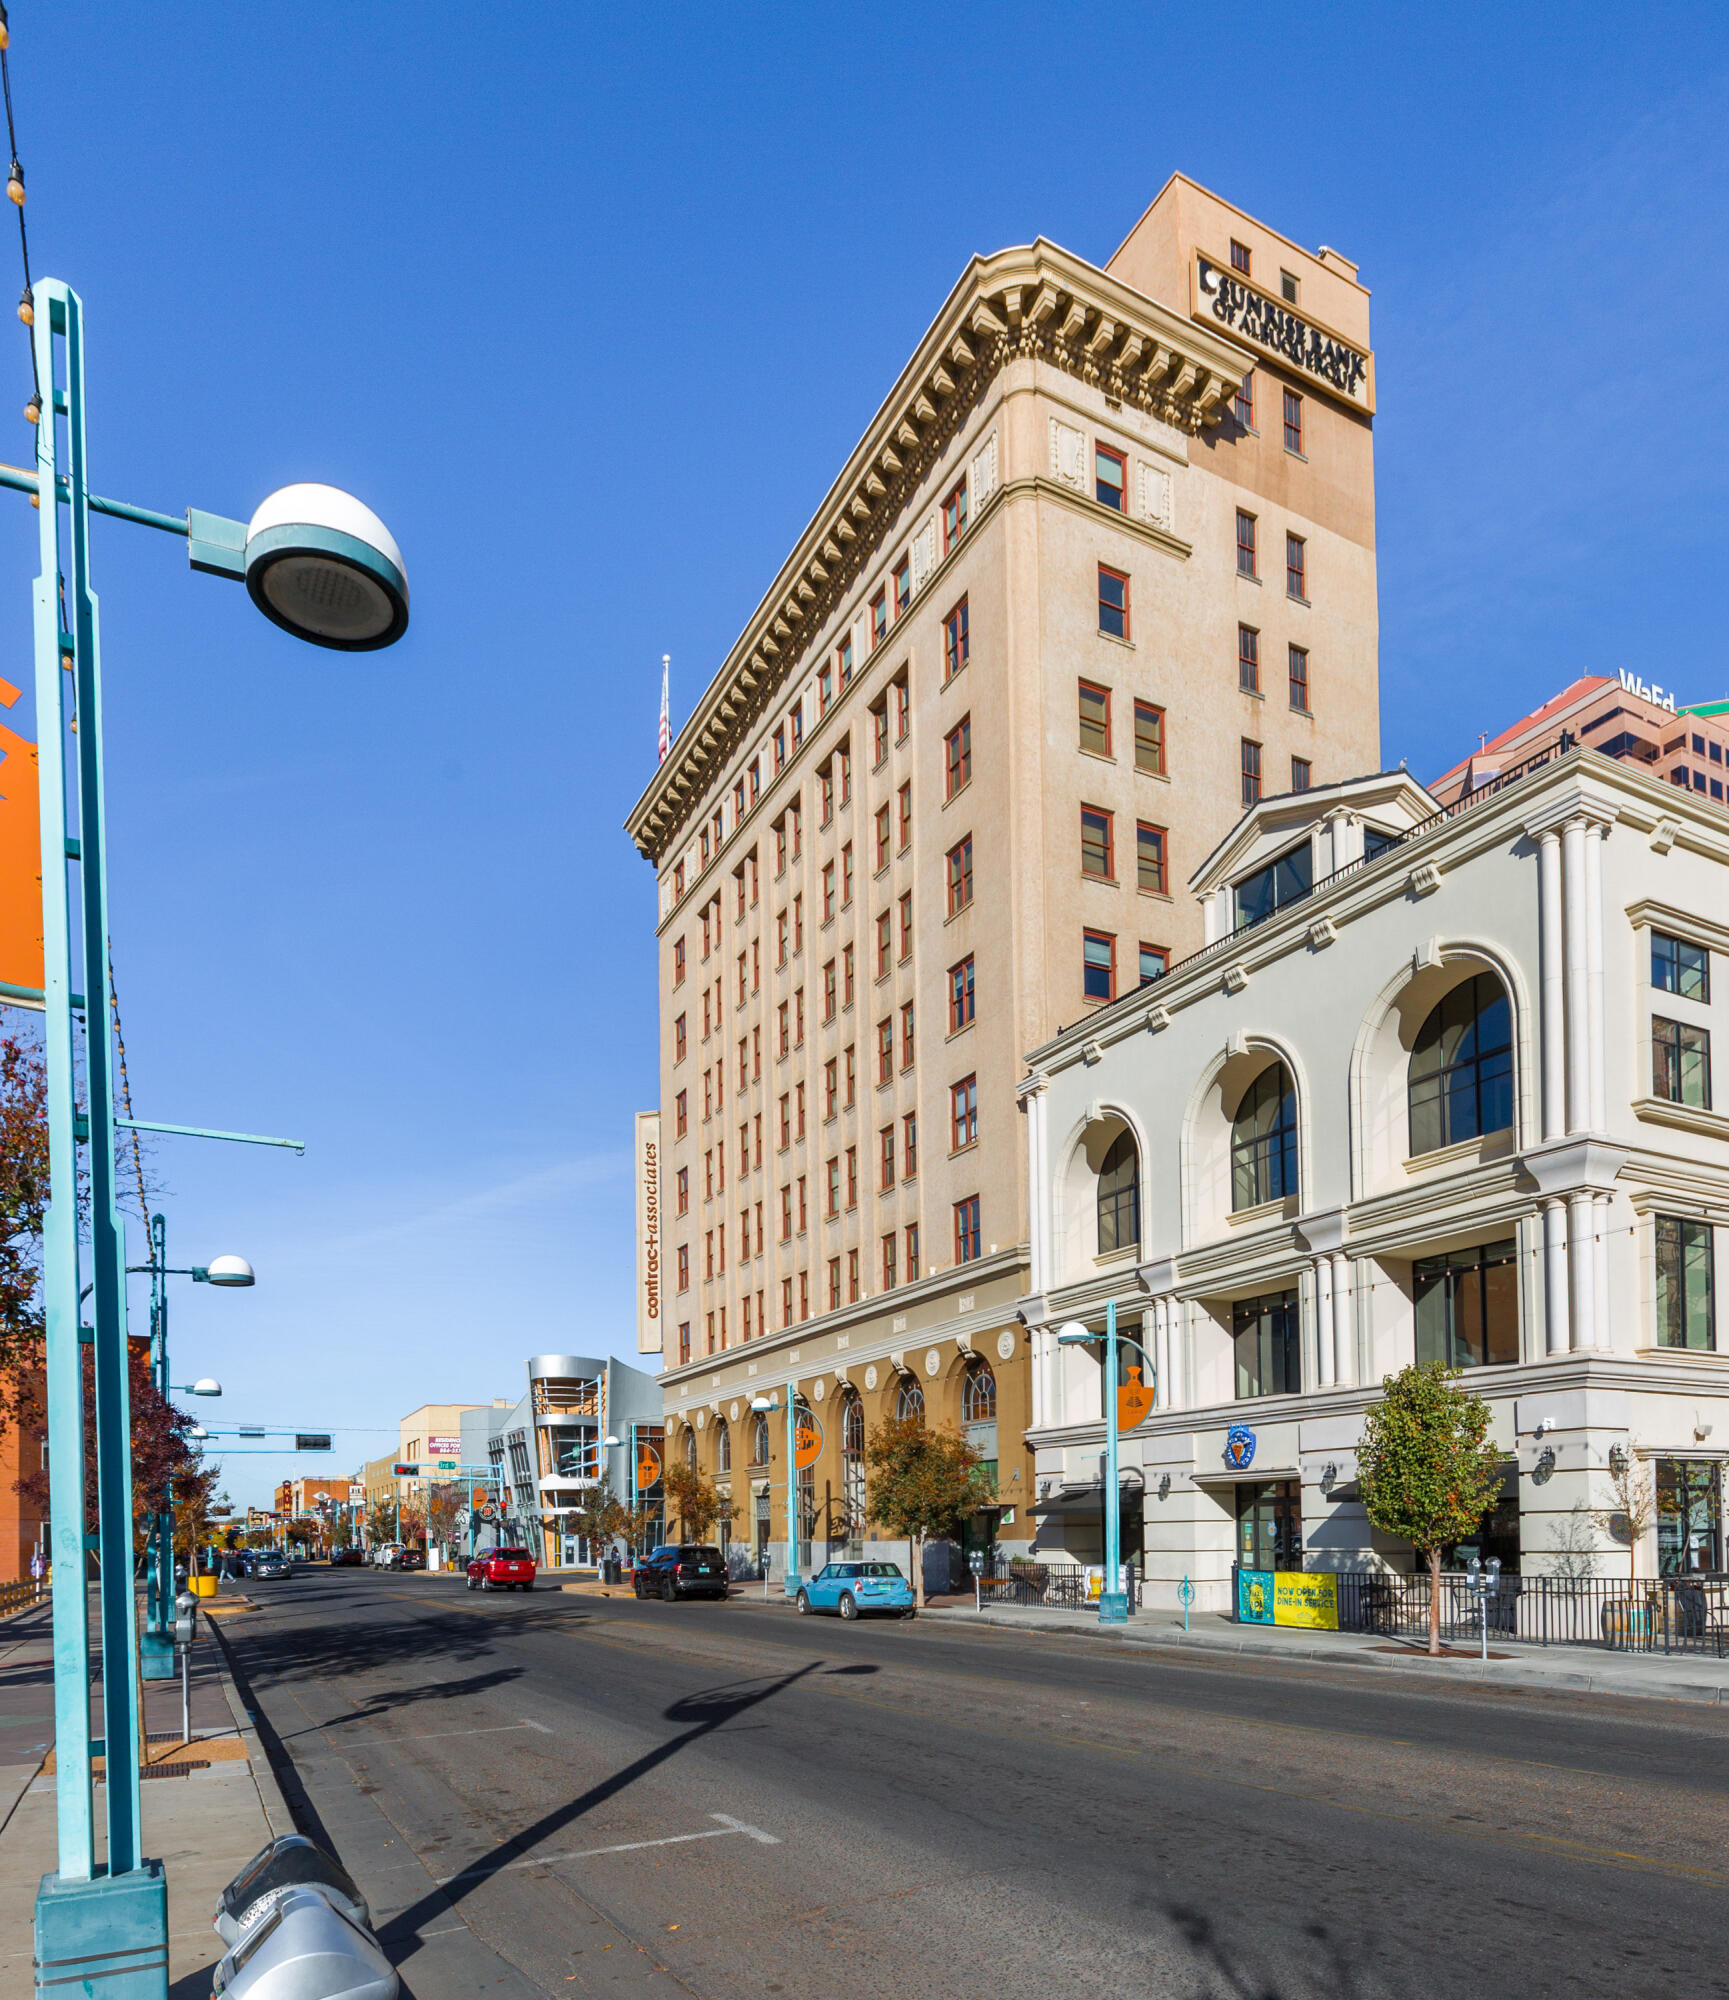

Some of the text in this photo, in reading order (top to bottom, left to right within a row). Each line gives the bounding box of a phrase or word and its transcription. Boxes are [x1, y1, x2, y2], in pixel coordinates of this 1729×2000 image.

[1212, 297, 1356, 397] OF ALBUQUERQUE
[1219, 276, 1367, 382] SUNRISE BANK
[1276, 1597, 1334, 1609] DINE-IN SERVICE
[1277, 1587, 1333, 1598] NOW OPEN FOR
